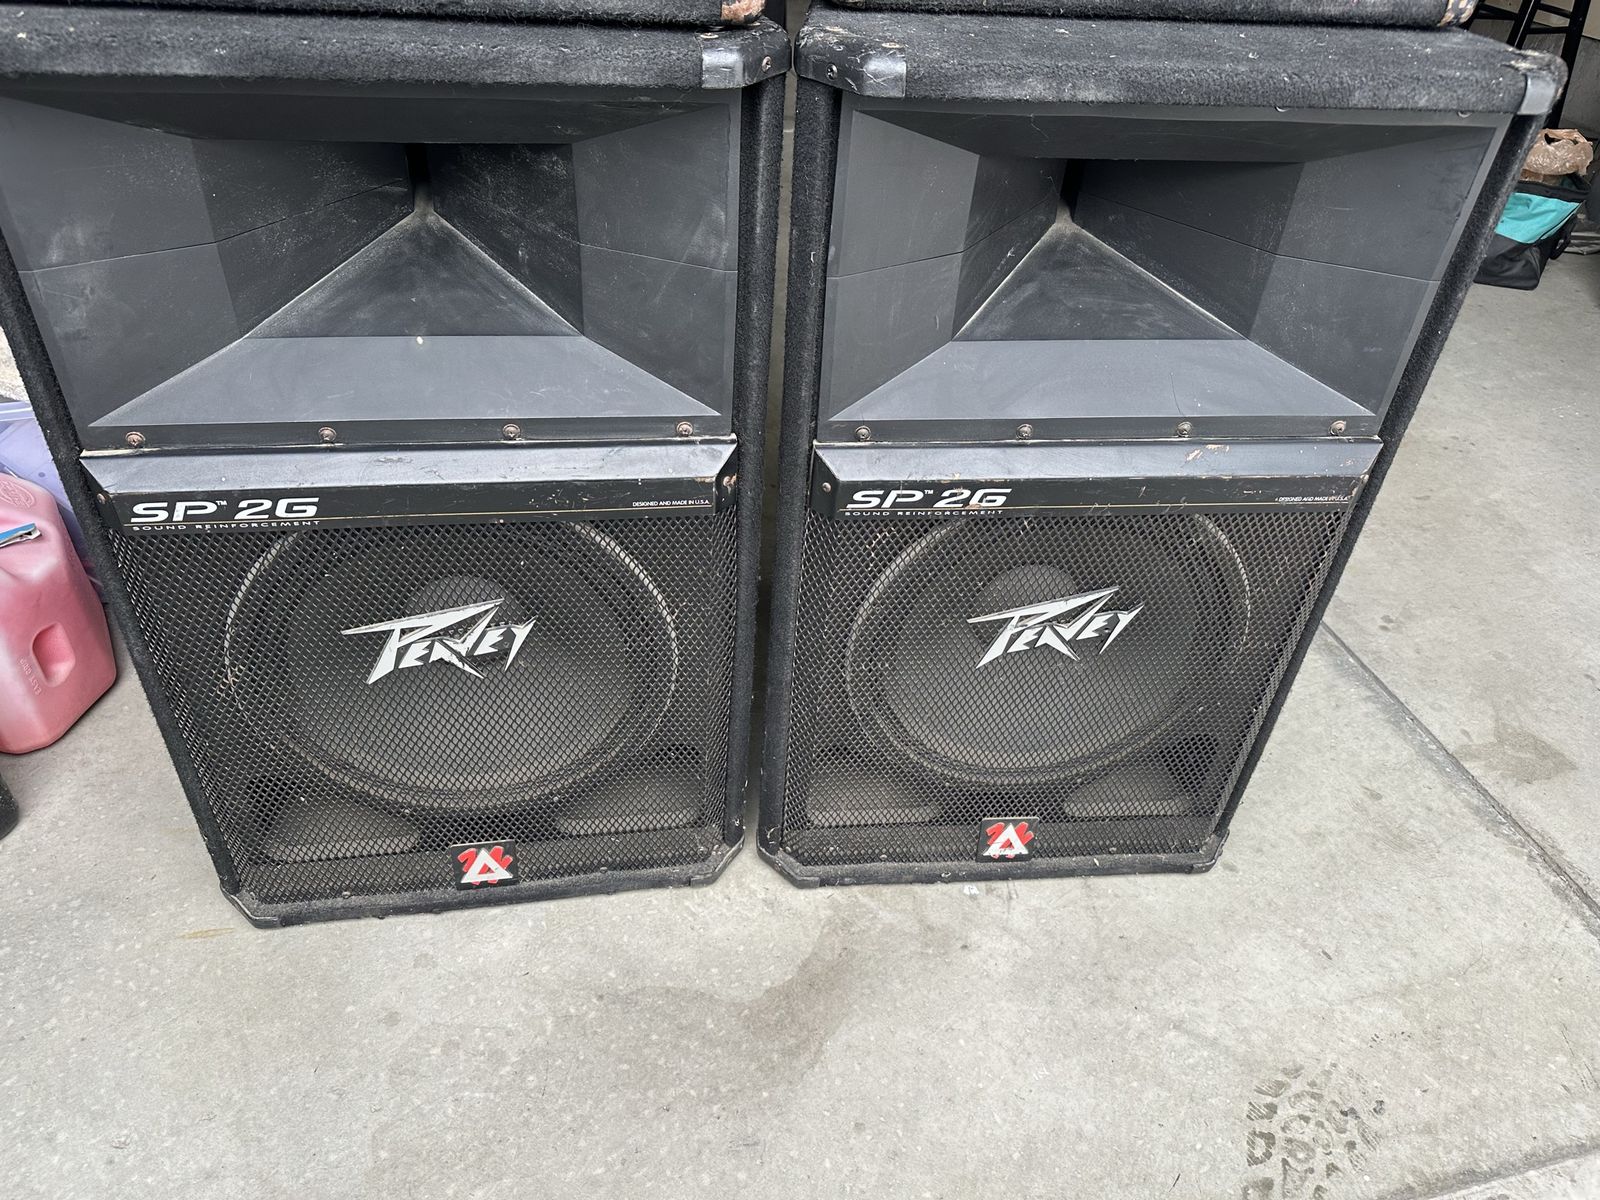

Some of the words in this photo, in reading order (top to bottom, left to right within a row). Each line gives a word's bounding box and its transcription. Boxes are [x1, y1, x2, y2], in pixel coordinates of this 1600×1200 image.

[234, 497, 320, 520] 2G
[933, 488, 1013, 508] 2G
[195, 520, 320, 530] REINFORCEMENT
[966, 586, 1145, 670] PEAVEY
[340, 598, 538, 685] PEAVEY
